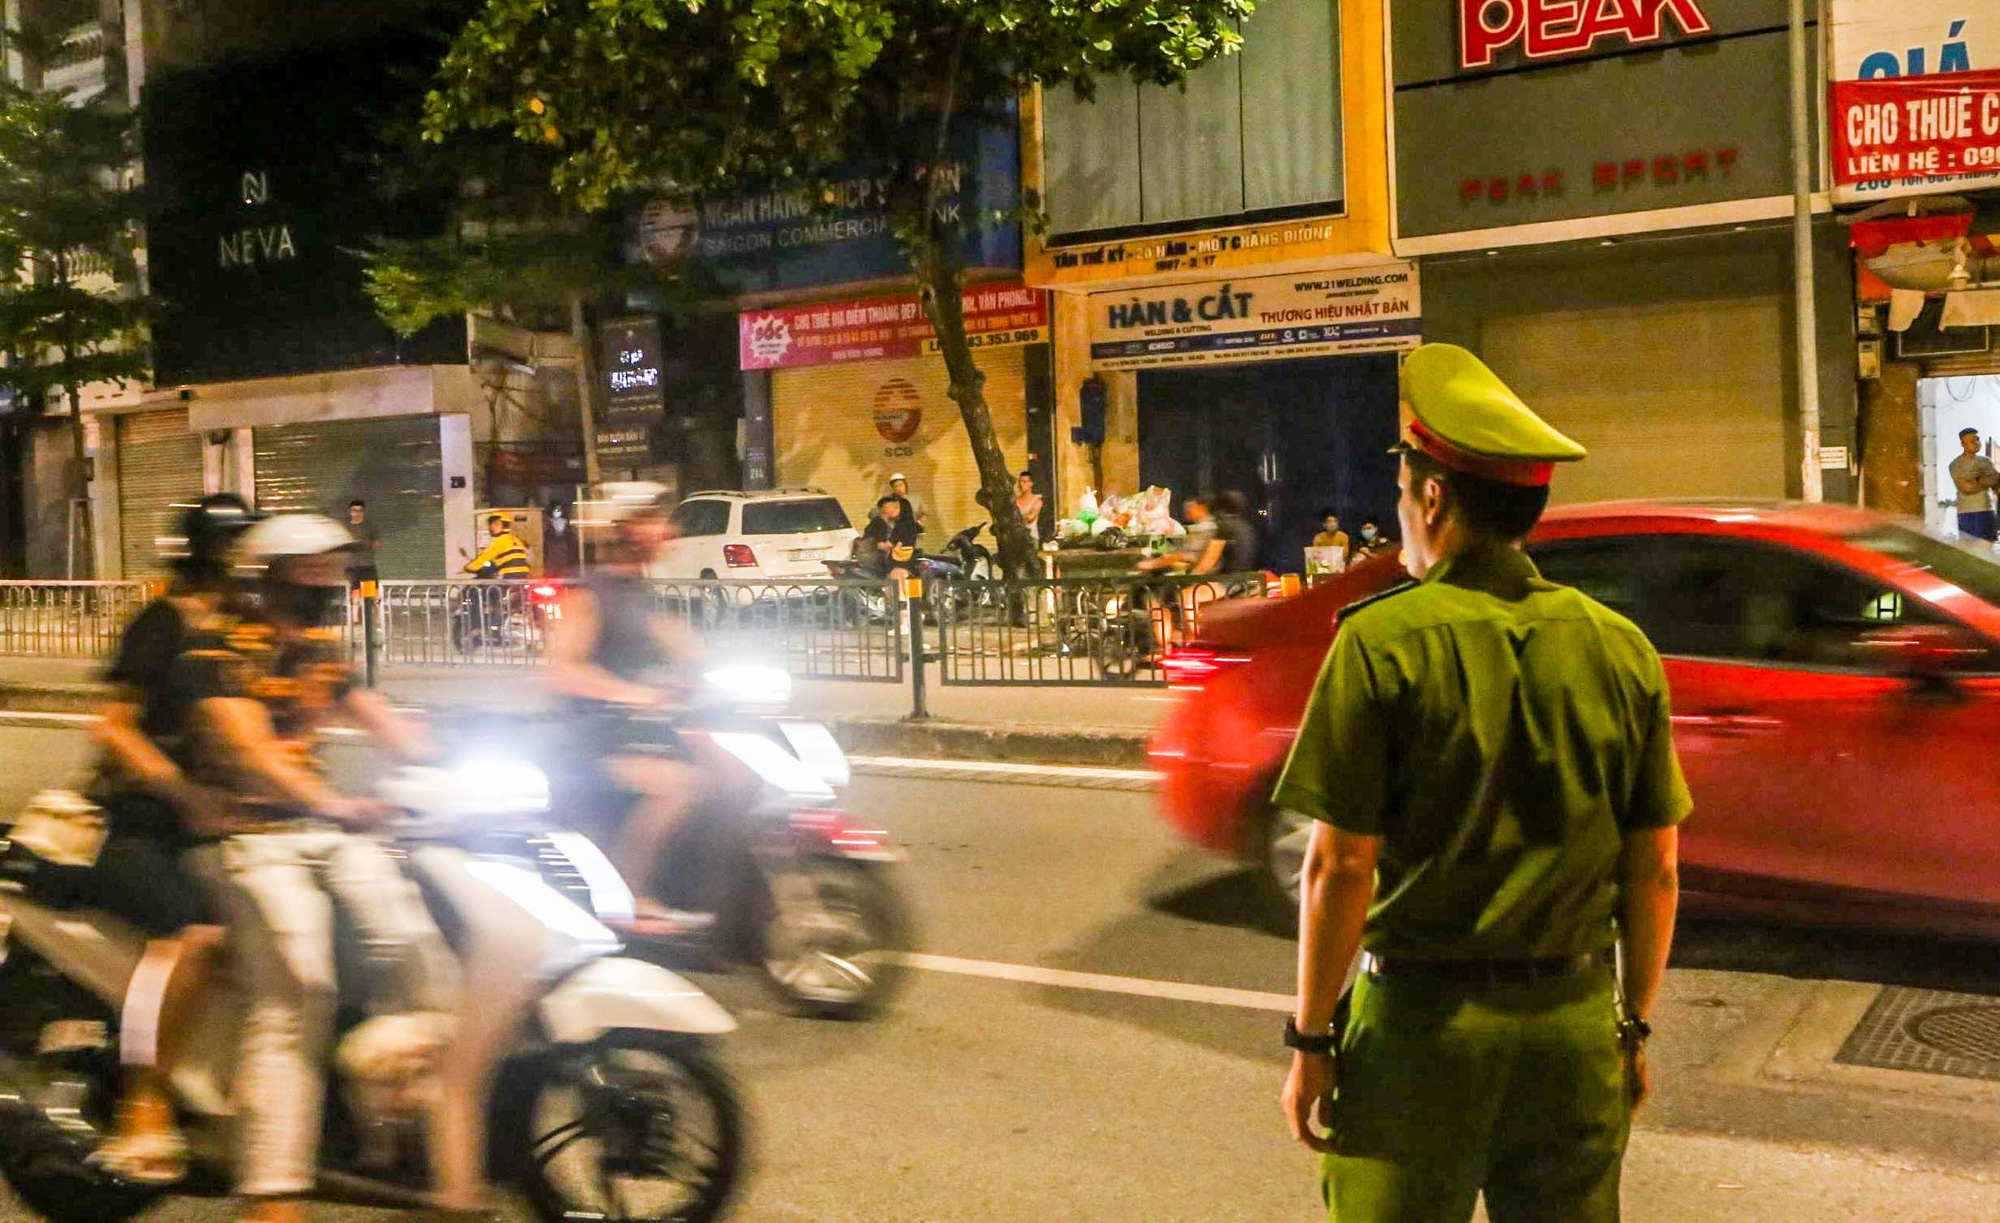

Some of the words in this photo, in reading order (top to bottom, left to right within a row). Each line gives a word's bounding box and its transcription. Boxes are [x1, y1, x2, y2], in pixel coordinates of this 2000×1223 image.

[1461, 0, 1712, 69] PEAK
[1847, 102, 1899, 147] CHO
[1906, 87, 1973, 142] THUÊ
[1848, 151, 1900, 176] LIÊN
[1908, 147, 1941, 174] HỆ
[220, 226, 295, 267] NEVA
[778, 215, 888, 248] COMMERCI
[1294, 273, 1408, 292] WWW.21WELDING.COM
[1108, 297, 1167, 329] HÀN
[1171, 298, 1193, 323] &
[1197, 283, 1254, 321] CẮT
[1260, 308, 1312, 324] THƯƠNG
[1315, 304, 1343, 321] HIỆU
[1345, 303, 1380, 318] NHẬT
[1382, 297, 1410, 312] BẢN
[884, 446, 914, 457] SCB
